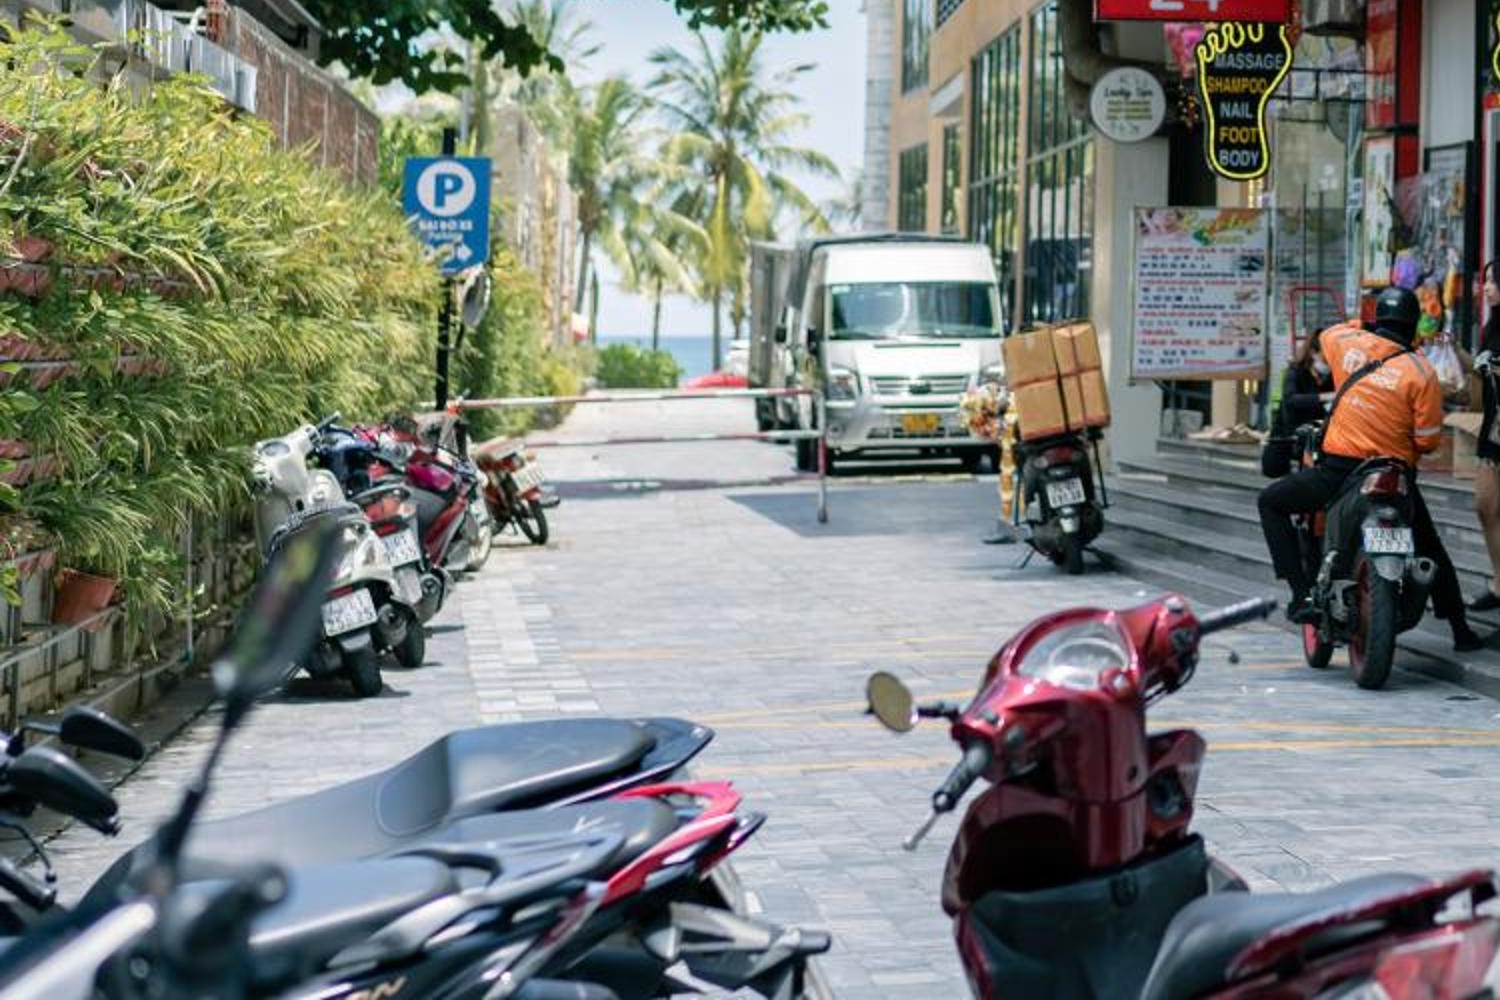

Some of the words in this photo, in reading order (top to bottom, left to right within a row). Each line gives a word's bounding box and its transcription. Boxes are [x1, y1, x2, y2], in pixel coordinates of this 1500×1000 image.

[1214, 53, 1284, 69] MASSAGE
[1206, 77, 1267, 94] SHAMPOO
[1220, 103, 1253, 118] NAIL
[1219, 127, 1258, 143] FOOT
[1219, 151, 1258, 167] BODY
[433, 173, 464, 209] P
